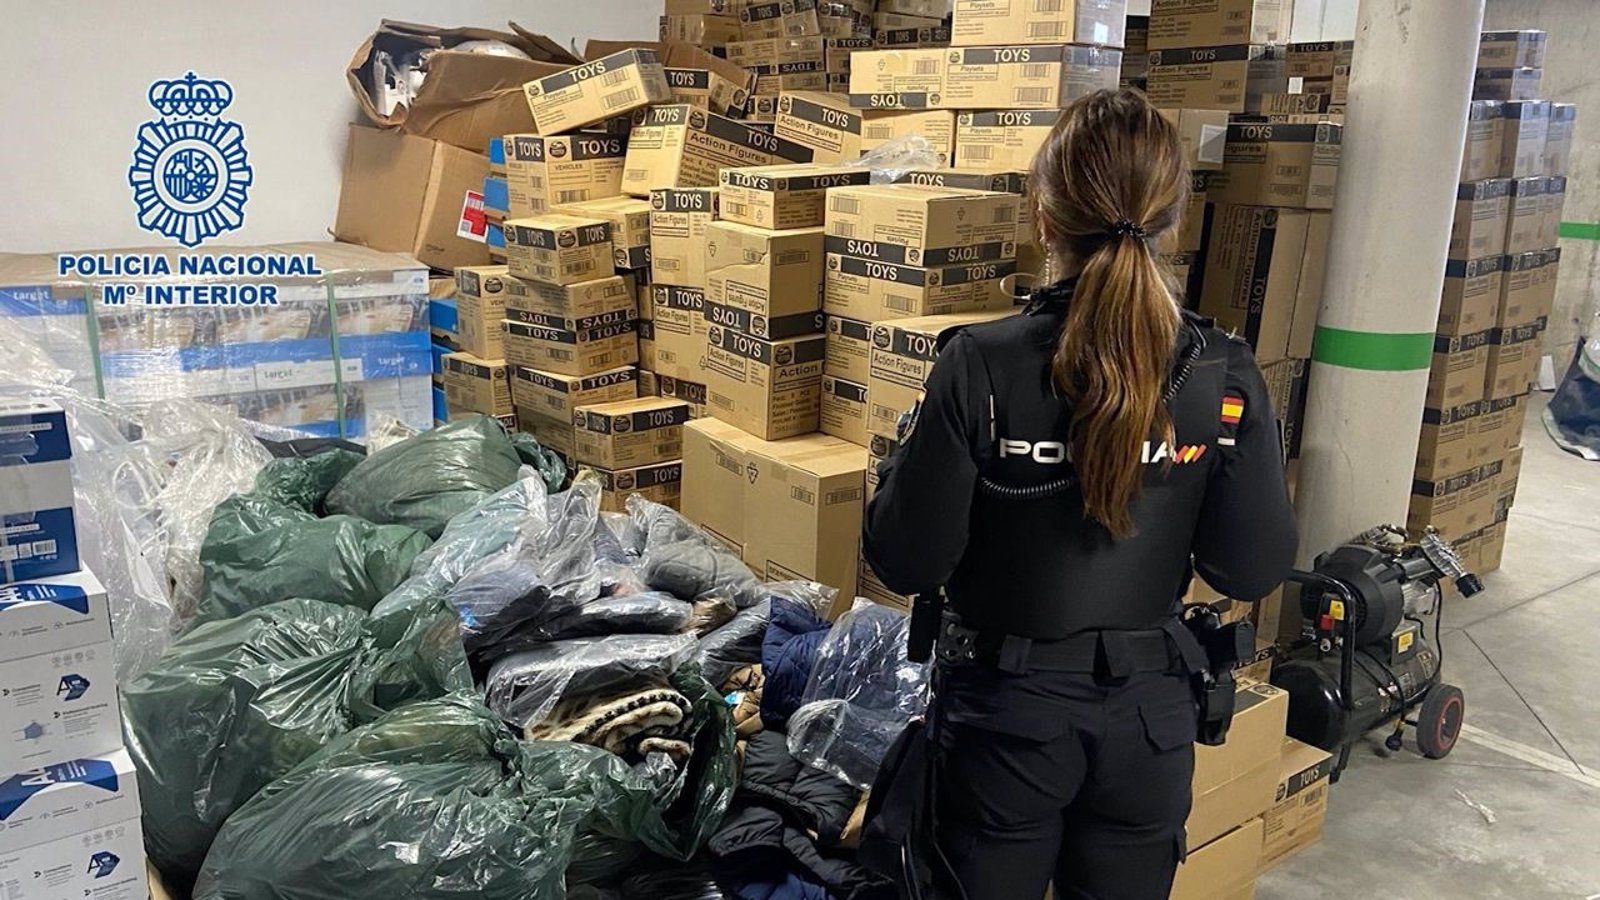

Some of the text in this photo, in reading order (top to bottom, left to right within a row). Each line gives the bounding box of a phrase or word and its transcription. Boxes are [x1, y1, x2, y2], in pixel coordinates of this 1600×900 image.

[993, 49, 1031, 62] TOYS
[1191, 49, 1216, 61] TOYS
[569, 61, 606, 83] TOYS
[782, 63, 811, 72] TOYS
[1151, 64, 1209, 74] Action Figures
[670, 72, 695, 86] TOYS
[870, 94, 902, 108] TOYS
[653, 108, 680, 123] TOYS
[821, 108, 850, 128] TOYS
[996, 112, 1031, 125] TOYS
[780, 115, 806, 130] Action
[807, 124, 839, 140] Figures
[1240, 126, 1273, 139] TOYS
[518, 142, 541, 157] TOYS
[578, 139, 620, 155] TOYS
[690, 132, 768, 165] Action Figures
[747, 131, 778, 152] TOYS
[555, 163, 583, 171] VEHICLES
[734, 174, 770, 190] TOYS
[811, 174, 851, 188] TOYS
[909, 173, 944, 187] TOYS
[674, 193, 703, 209] TOYS
[654, 213, 687, 226] Action Figures
[526, 230, 545, 246] TOYS
[585, 227, 605, 242] TOYS
[847, 240, 880, 257] TOYS
[948, 248, 980, 261] TOYS
[865, 262, 898, 280] TOYS
[966, 264, 997, 281] TOYS
[14, 291, 49, 301] target
[675, 290, 703, 308] TOYS
[1251, 277, 1266, 314] TOYS
[519, 312, 549, 326] TOYS
[582, 313, 622, 328] TOYS
[656, 308, 688, 323] Action Figures
[713, 307, 741, 328] TOYS
[526, 326, 560, 342] TOYS
[596, 322, 632, 339] TOYS
[732, 334, 762, 358] TOYS
[906, 334, 940, 357] TOY
[1467, 334, 1486, 346] TOYS
[710, 348, 744, 369] Action Figures
[874, 353, 922, 376] Action Figures
[264, 368, 293, 380] target
[779, 363, 817, 379] Action
[529, 373, 555, 388] TOYS
[589, 371, 631, 388] TOYS
[648, 409, 674, 426] TOYS
[1456, 404, 1477, 417] TOYS
[1000, 438, 1175, 464] POIA
[653, 466, 680, 483] TOYS
[1300, 767, 1320, 786] TOYS
